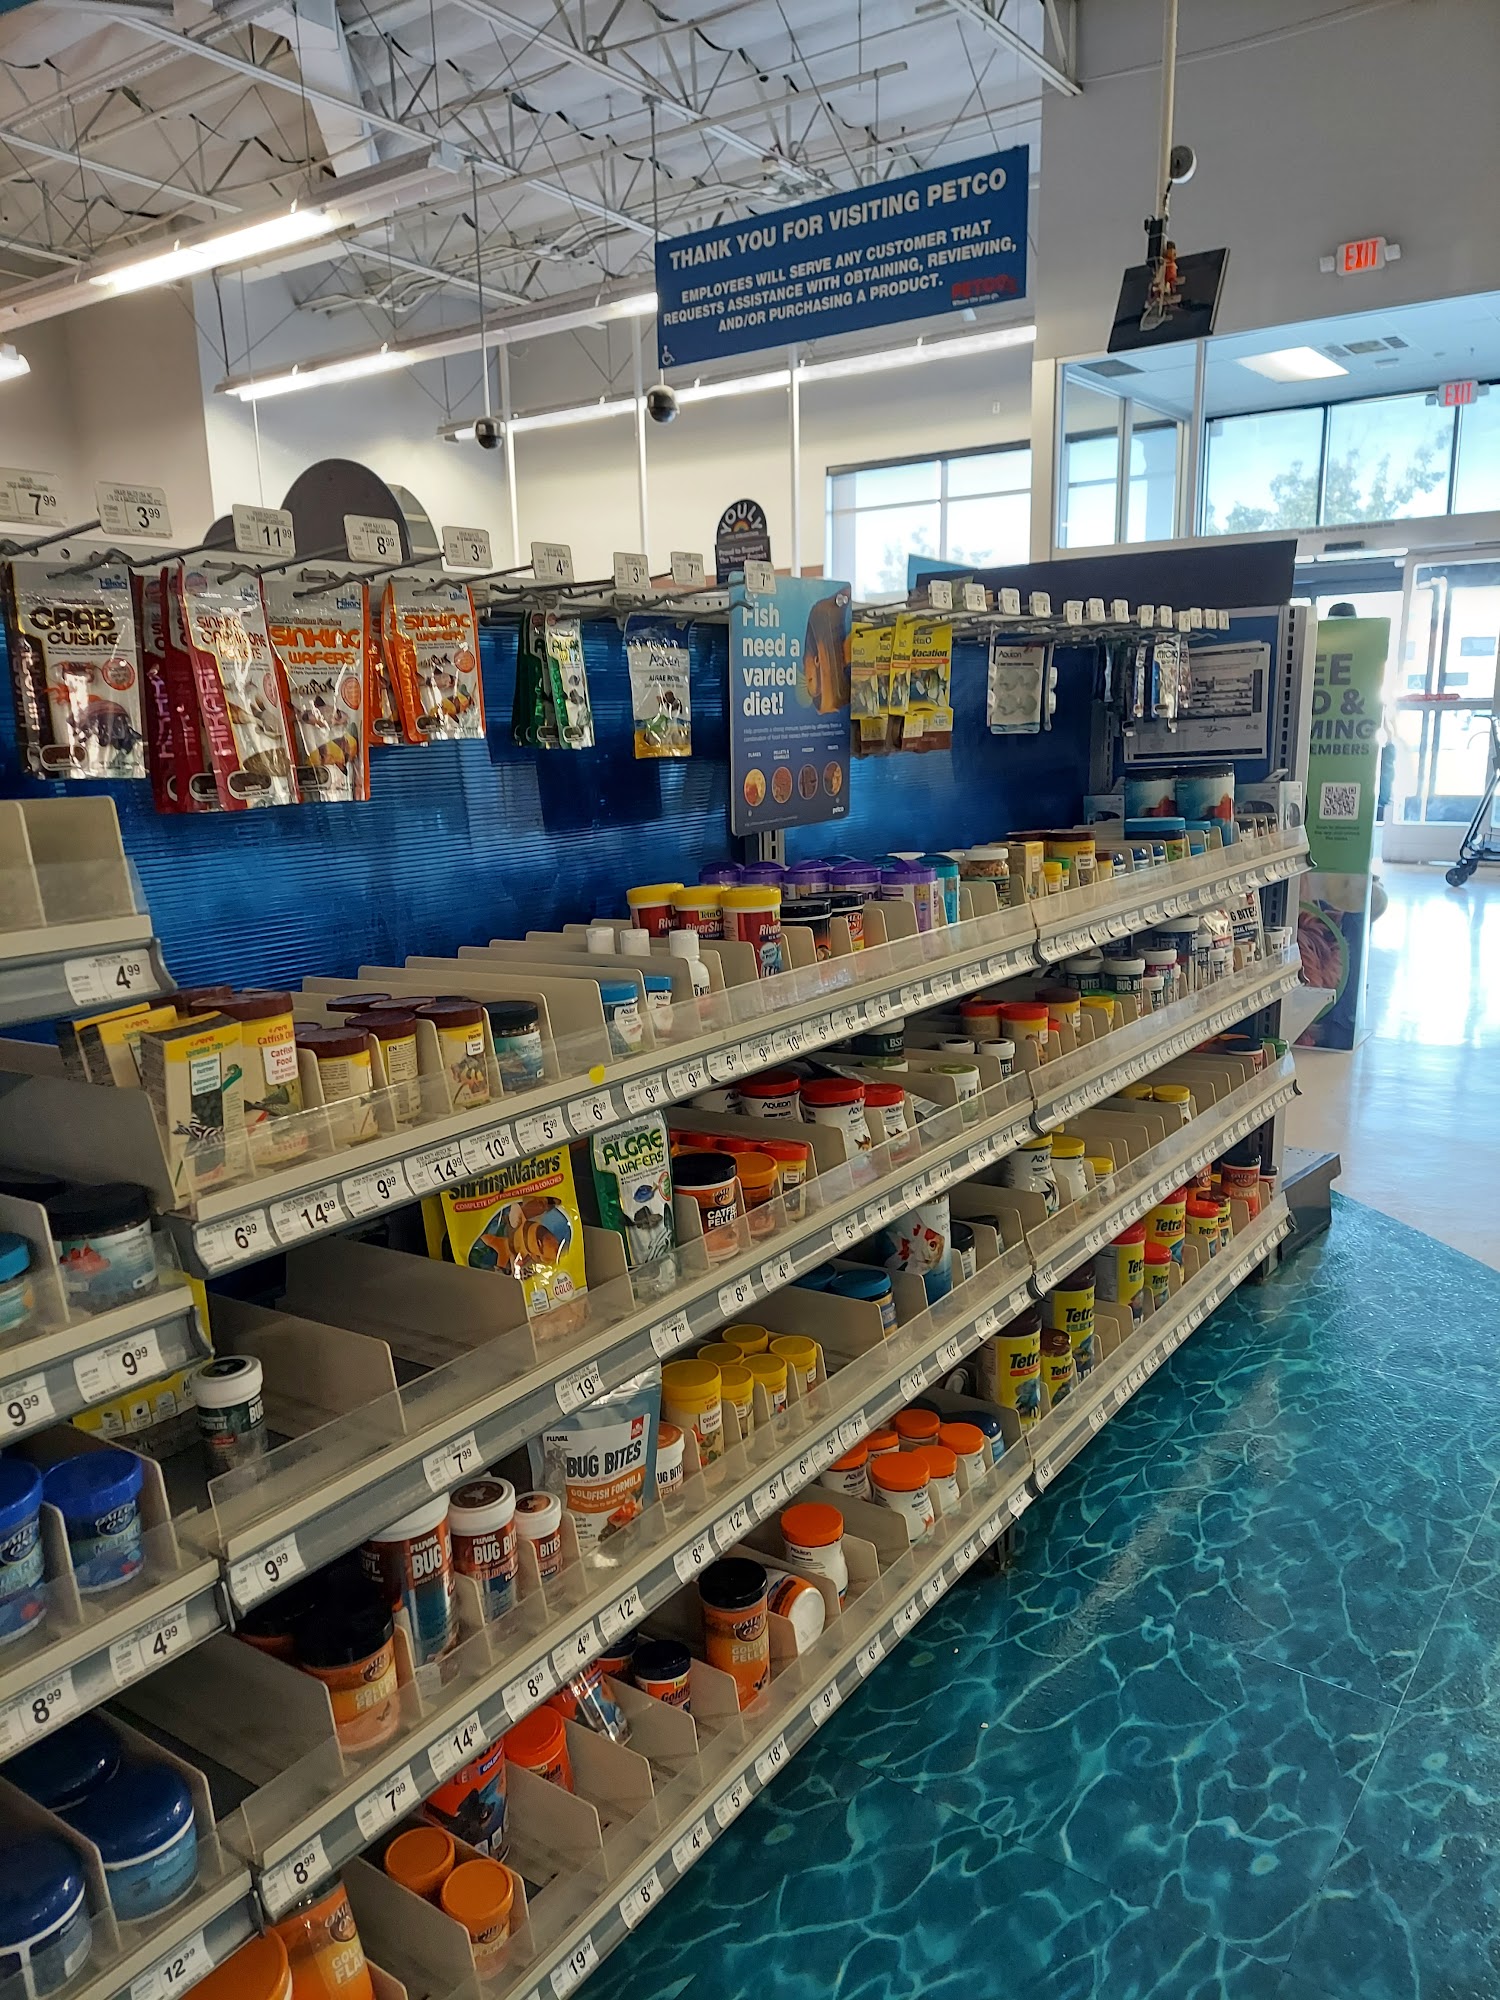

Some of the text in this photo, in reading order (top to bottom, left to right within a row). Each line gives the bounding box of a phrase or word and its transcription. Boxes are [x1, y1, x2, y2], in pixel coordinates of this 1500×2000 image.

[669, 167, 1007, 270] THANK YOU FOR VISITING PETCO
[681, 219, 992, 304] EMPLOYEES WILL SERVE ANY CUSTOMER THAT
[1344, 240, 1378, 271] EXIT
[663, 236, 1017, 326] REQUESTS ASSISTANCE WITH OBTAINING, REVIEWING,
[718, 272, 943, 333] AND/OR PURCHASING A PRODUCT.
[1445, 382, 1472, 406] EXIT
[720, 502, 763, 535] YOULY
[28, 606, 116, 631] CRAB
[403, 613, 471, 630] SINKING
[742, 600, 780, 628] Fish
[47, 631, 119, 647] CUISINE
[269, 625, 361, 650] SINKING
[415, 630, 466, 642] WAFERS
[742, 635, 801, 658] need a
[288, 651, 356, 665] WAFERS
[742, 661, 797, 687] varied
[197, 668, 232, 757] HIKARI
[743, 691, 784, 717] diet!
[1340, 688, 1366, 715] &
[832, 806, 845, 815] petco
[1237, 906, 1258, 920] BITES
[1081, 978, 1100, 989] BITES
[1116, 980, 1132, 991] BUG
[257, 1033, 284, 1045] Catfish
[270, 1046, 293, 1058] Catfish
[276, 1056, 293, 1067] Food
[602, 1128, 665, 1166] ALGAE
[617, 1151, 664, 1176] WAFERS
[449, 1154, 561, 1200] ShrimpWafers
[455, 1199, 488, 1211] COMPLETE
[499, 1189, 511, 1200] FOR
[511, 1185, 537, 1197] CATFISH
[554, 1279, 574, 1297] COLOR
[566, 1440, 642, 1479] BUG BITES
[571, 1473, 642, 1501] GOLDFISH FORMULA
[409, 1535, 438, 1554] FLUVAL
[473, 1534, 497, 1546] FLUVAL
[540, 1534, 561, 1558] BITES
[411, 1544, 443, 1580] BUG
[473, 1542, 501, 1565] BUG
